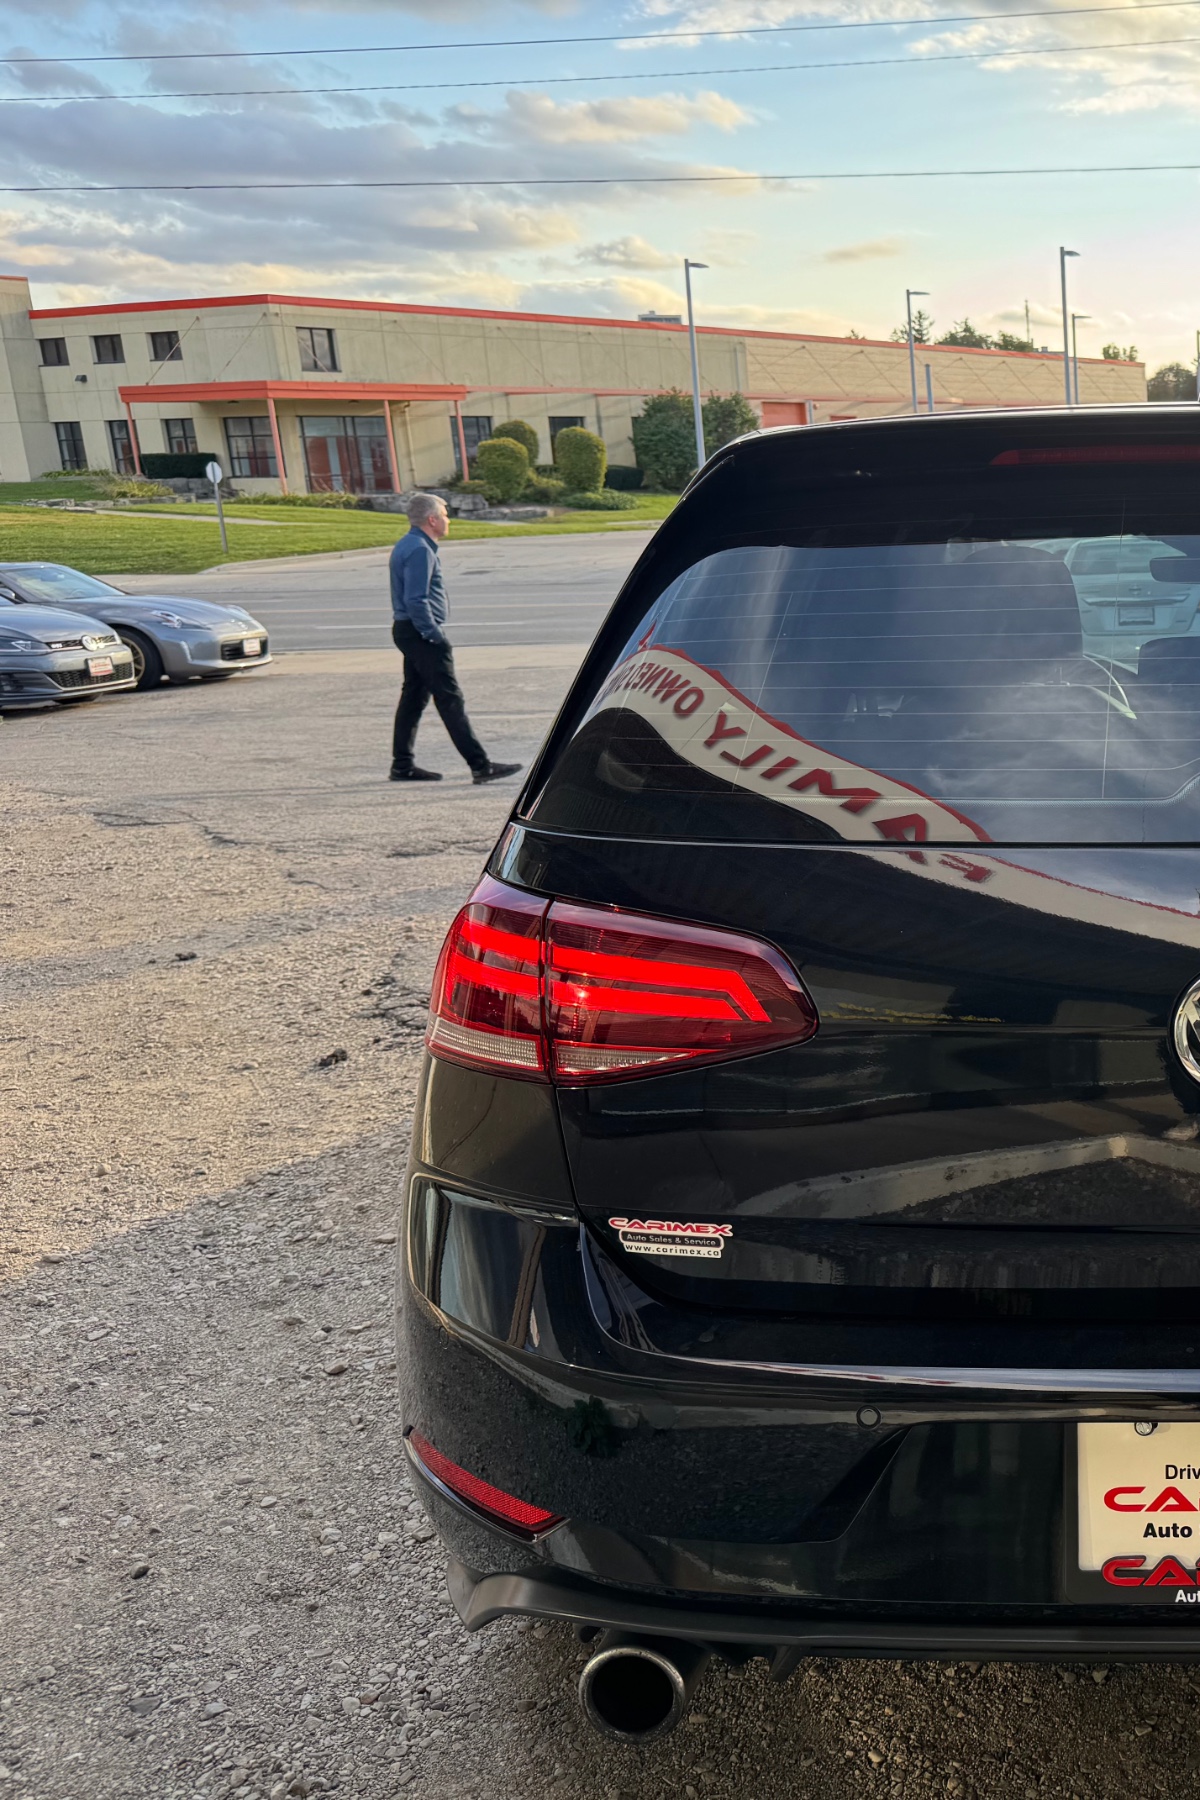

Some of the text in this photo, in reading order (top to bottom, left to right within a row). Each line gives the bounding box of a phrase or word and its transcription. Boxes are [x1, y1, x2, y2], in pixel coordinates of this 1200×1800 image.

[609, 1218, 731, 1235] CARIMEX
[627, 1233, 647, 1242] Auto
[649, 1235, 673, 1243] Sales
[684, 1237, 717, 1246] Service
[1143, 1522, 1193, 1538] Auto
